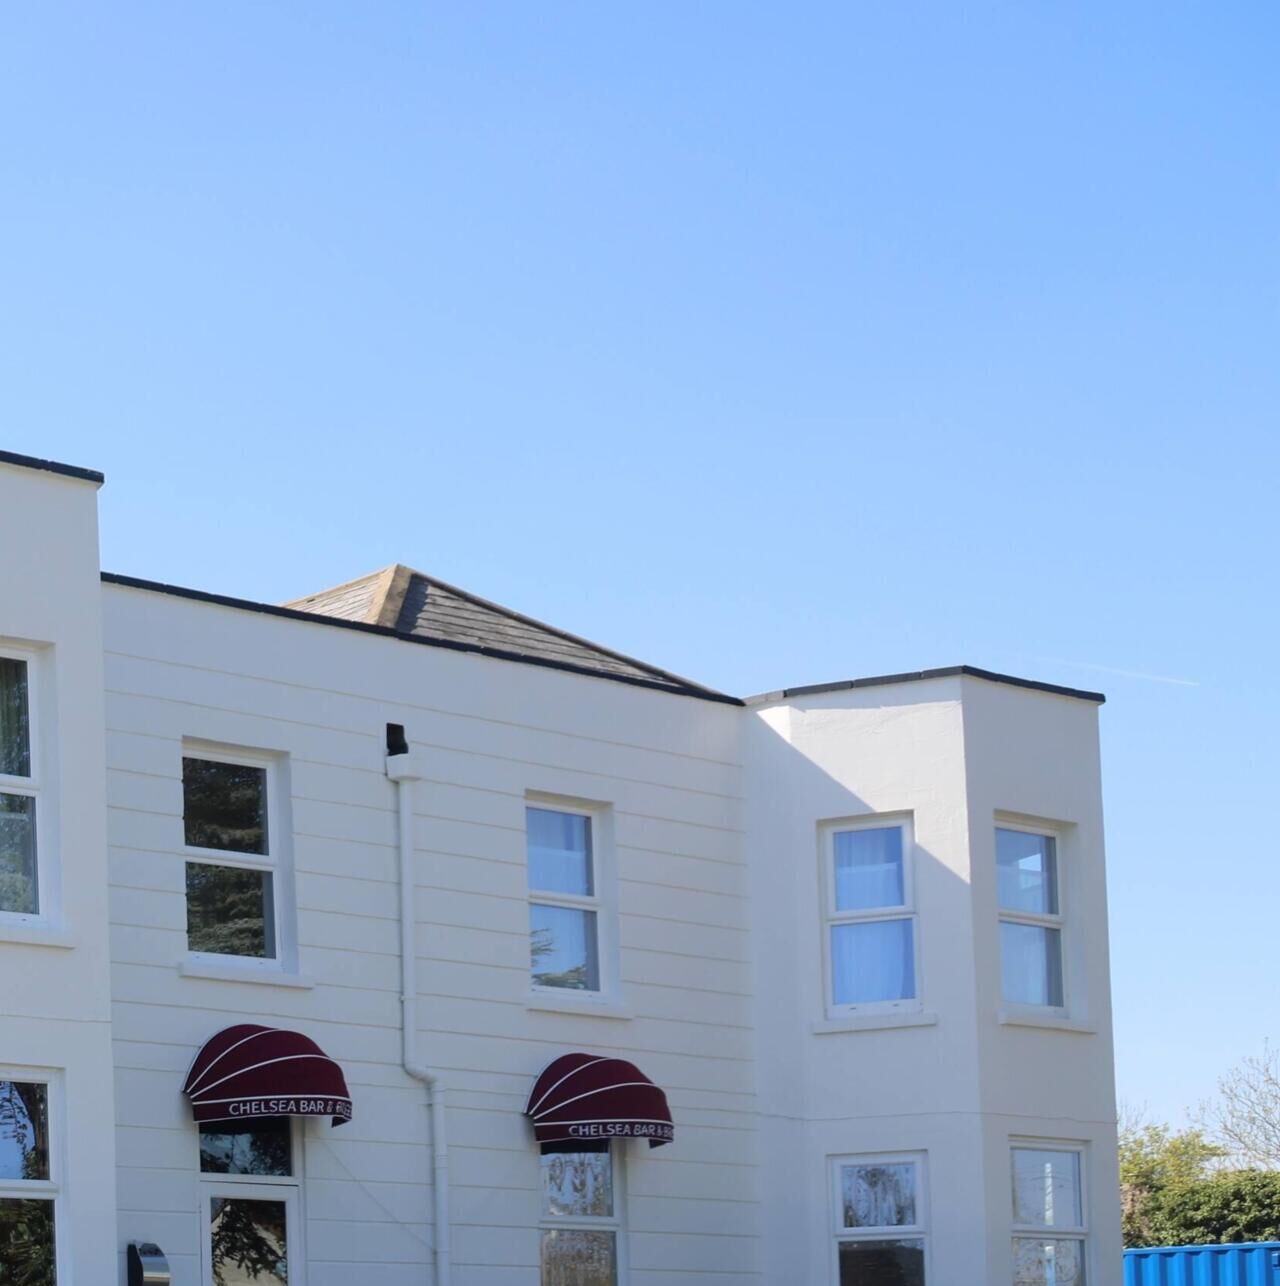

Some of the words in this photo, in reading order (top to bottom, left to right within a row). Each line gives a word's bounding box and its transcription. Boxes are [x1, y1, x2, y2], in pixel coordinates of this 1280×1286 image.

[228, 1100, 297, 1115] CHELSEA
[300, 1100, 325, 1113] BAR
[568, 1124, 631, 1136] CHELSEA
[633, 1124, 655, 1136] BAR
